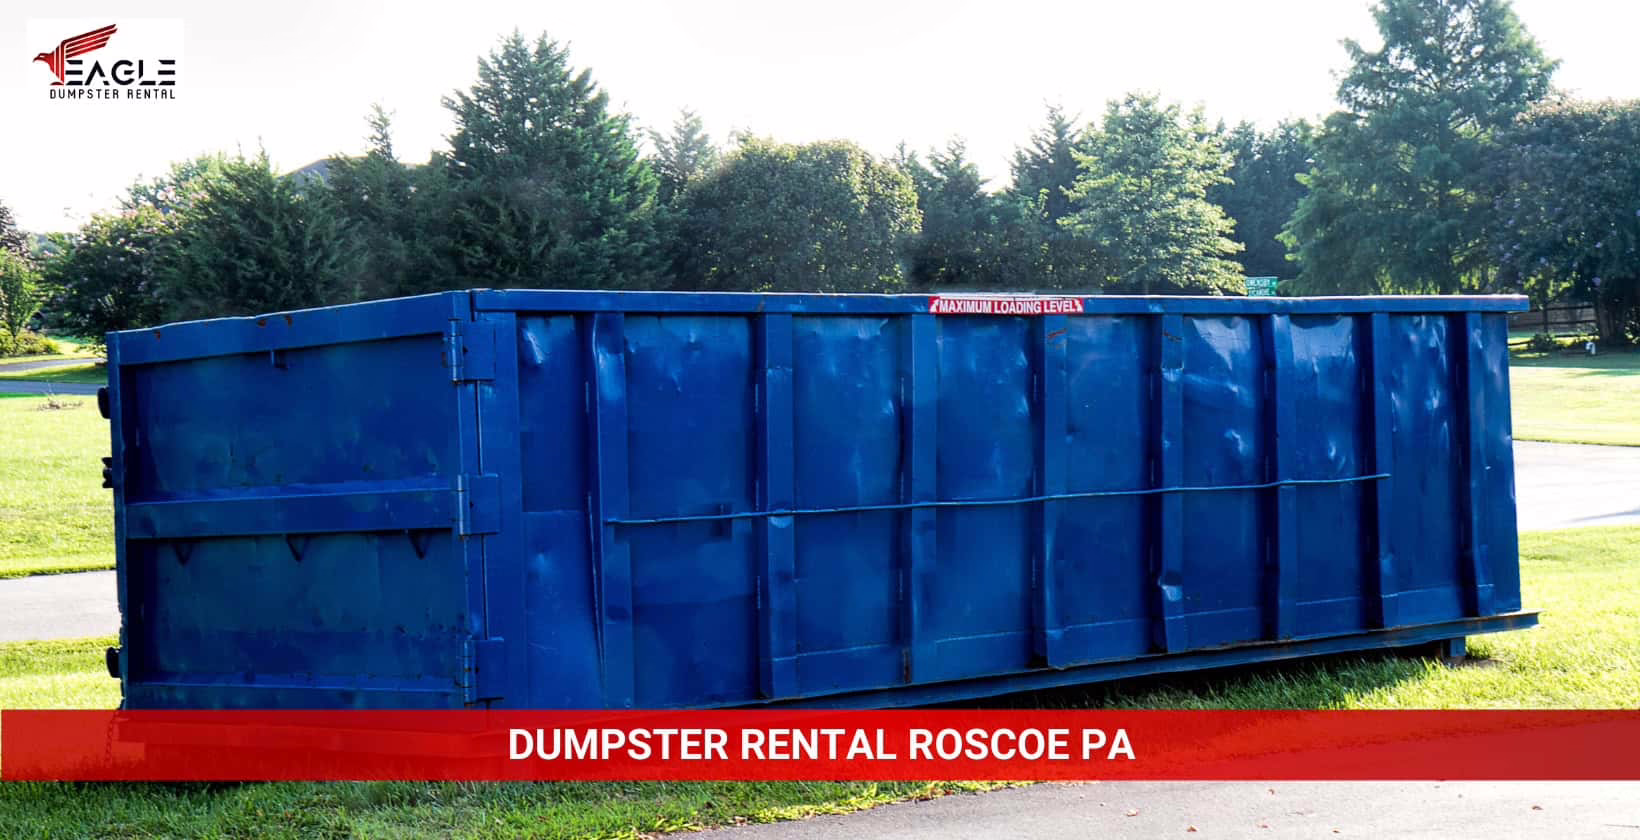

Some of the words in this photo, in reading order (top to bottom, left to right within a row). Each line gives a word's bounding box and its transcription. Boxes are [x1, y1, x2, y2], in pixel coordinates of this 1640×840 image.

[939, 299, 991, 313] MAXIMUM
[994, 300, 1042, 314] LOADING
[1044, 300, 1075, 313] LEVEL
